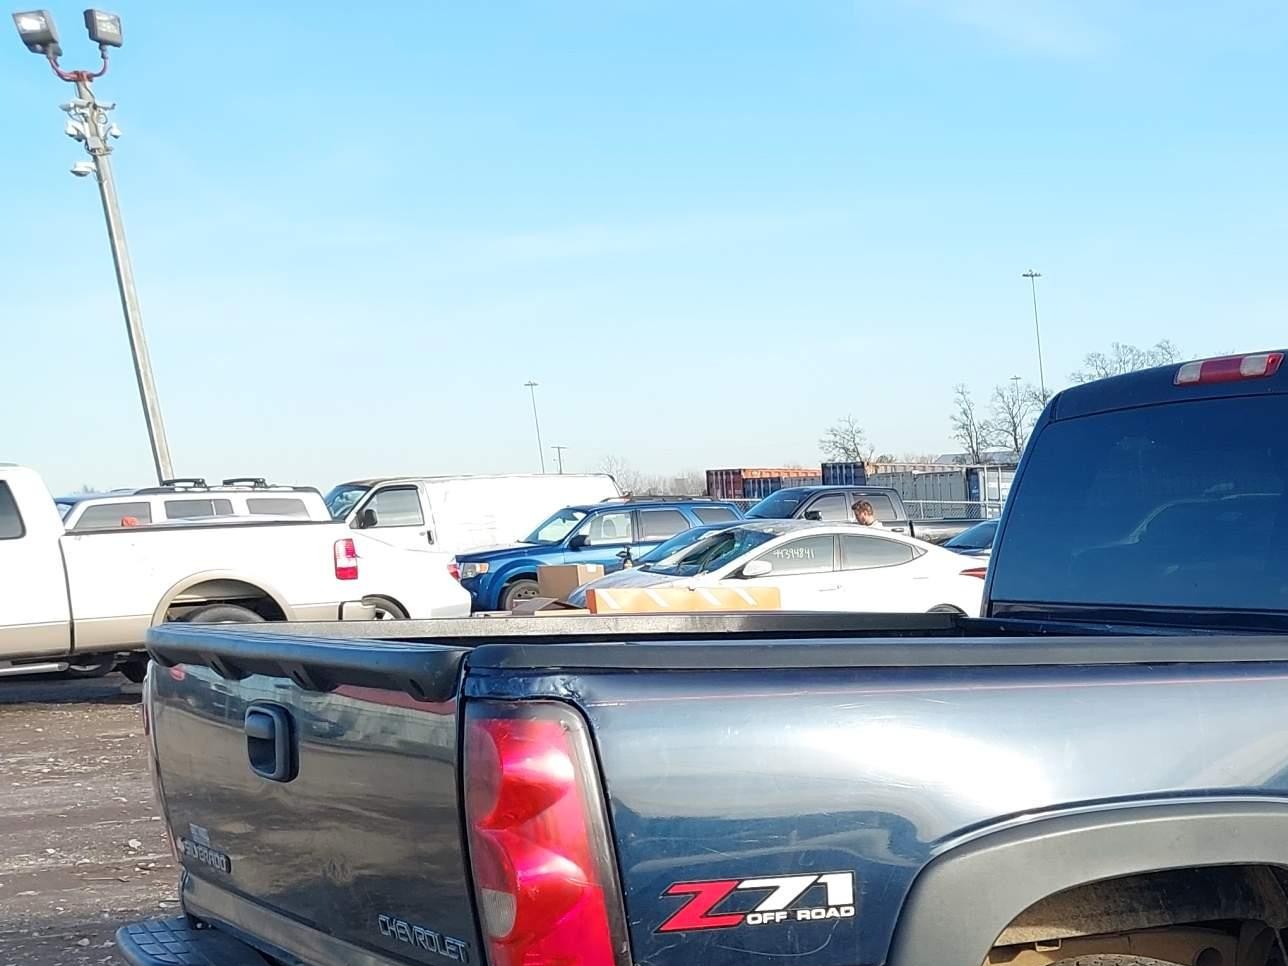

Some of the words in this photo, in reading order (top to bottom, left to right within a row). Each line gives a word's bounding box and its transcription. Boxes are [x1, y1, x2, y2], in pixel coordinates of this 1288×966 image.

[655, 871, 856, 933] Z71
[746, 910, 788, 926] OFF
[796, 905, 856, 921] ROAD
[378, 914, 466, 962] CHEVROLET
